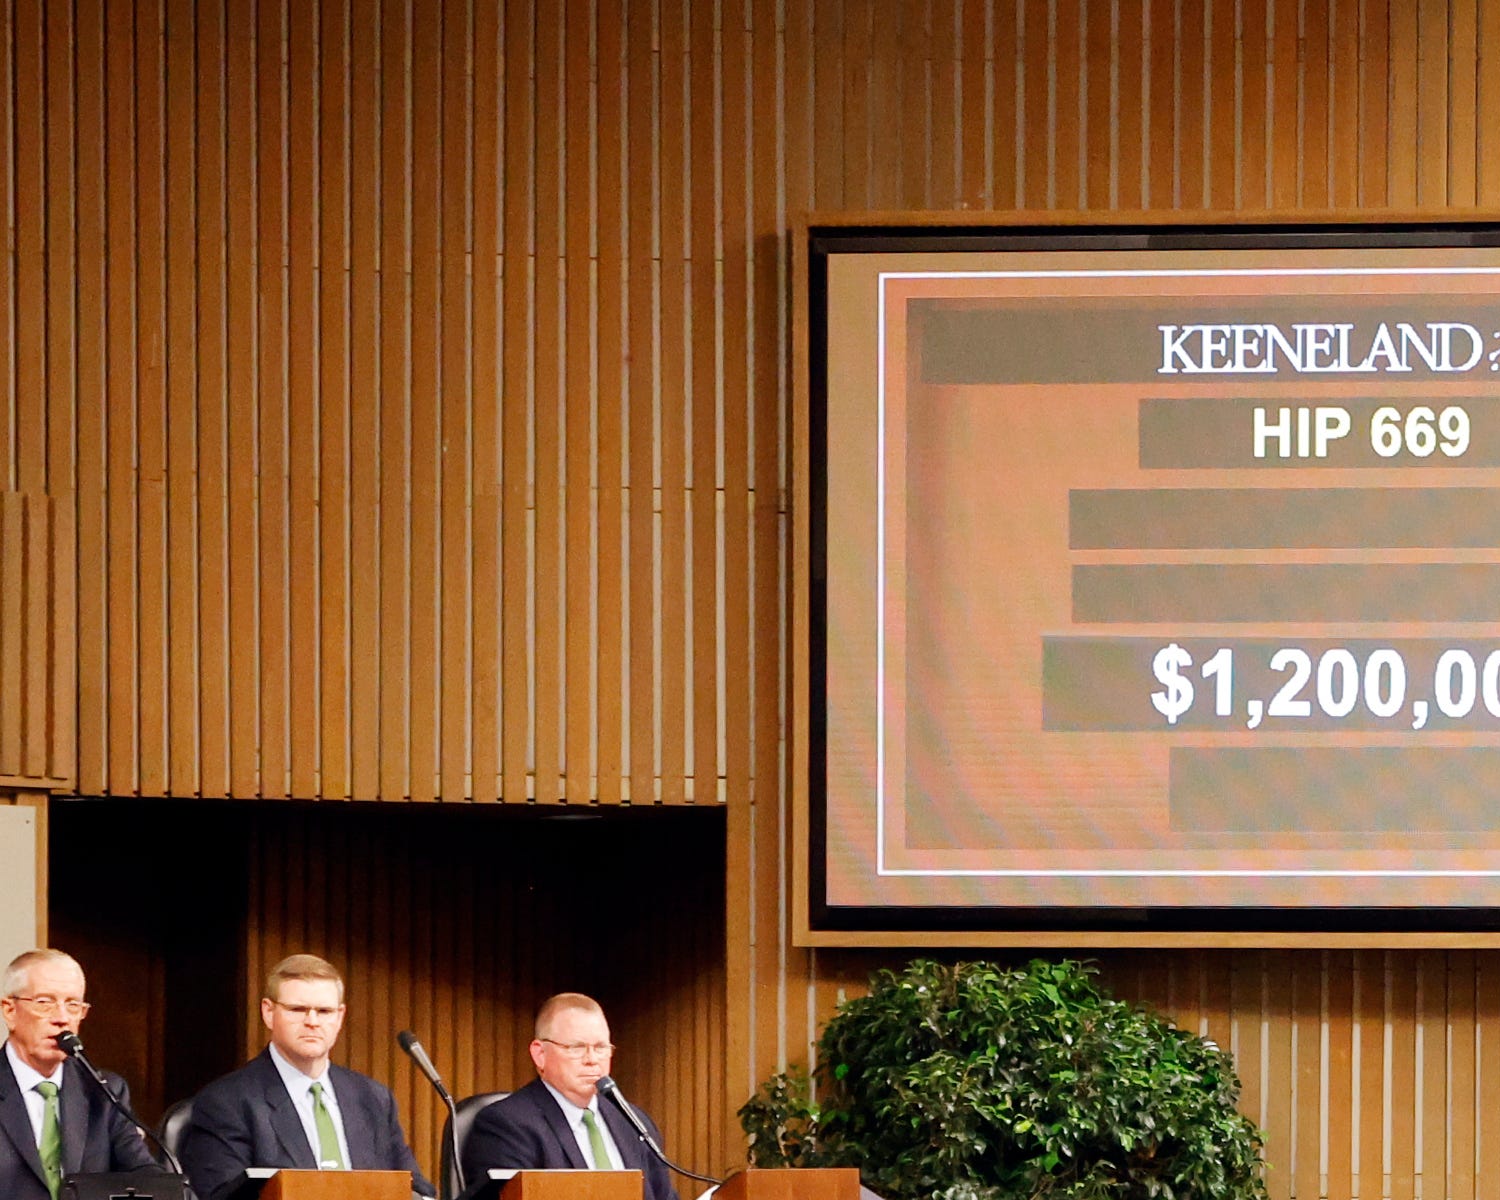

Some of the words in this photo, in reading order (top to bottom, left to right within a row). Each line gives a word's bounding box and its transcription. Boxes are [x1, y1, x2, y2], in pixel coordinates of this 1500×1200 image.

[1157, 322, 1484, 375] KEENELAND
[1252, 406, 1352, 459] HIP
[1370, 405, 1471, 459] 669
